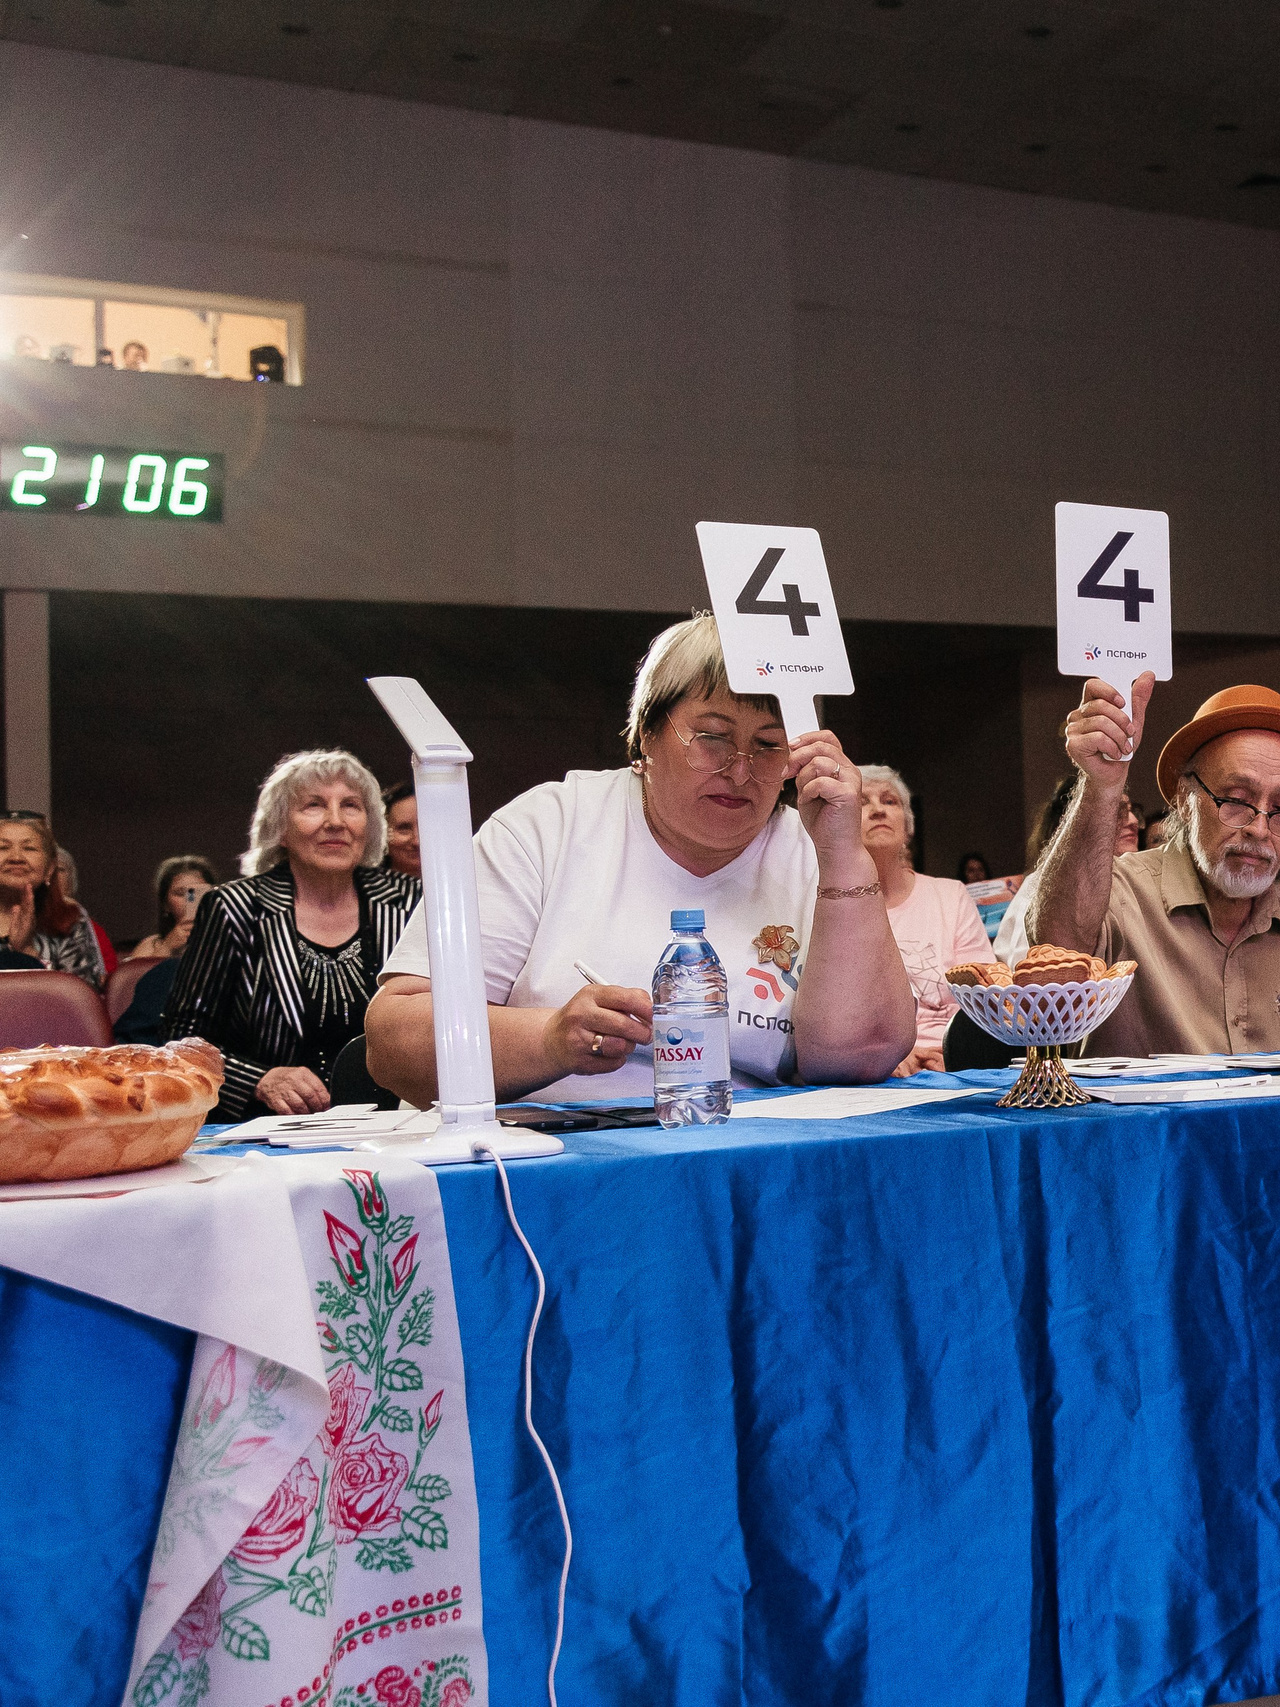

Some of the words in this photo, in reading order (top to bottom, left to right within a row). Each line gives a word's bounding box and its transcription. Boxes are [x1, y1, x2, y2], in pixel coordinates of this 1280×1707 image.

[1077, 531, 1155, 623] 4
[735, 547, 821, 637] 4
[1106, 649, 1147, 660] ПСПФНР
[779, 664, 824, 673] ПСПФНР
[655, 1046, 705, 1062] TASSAY
